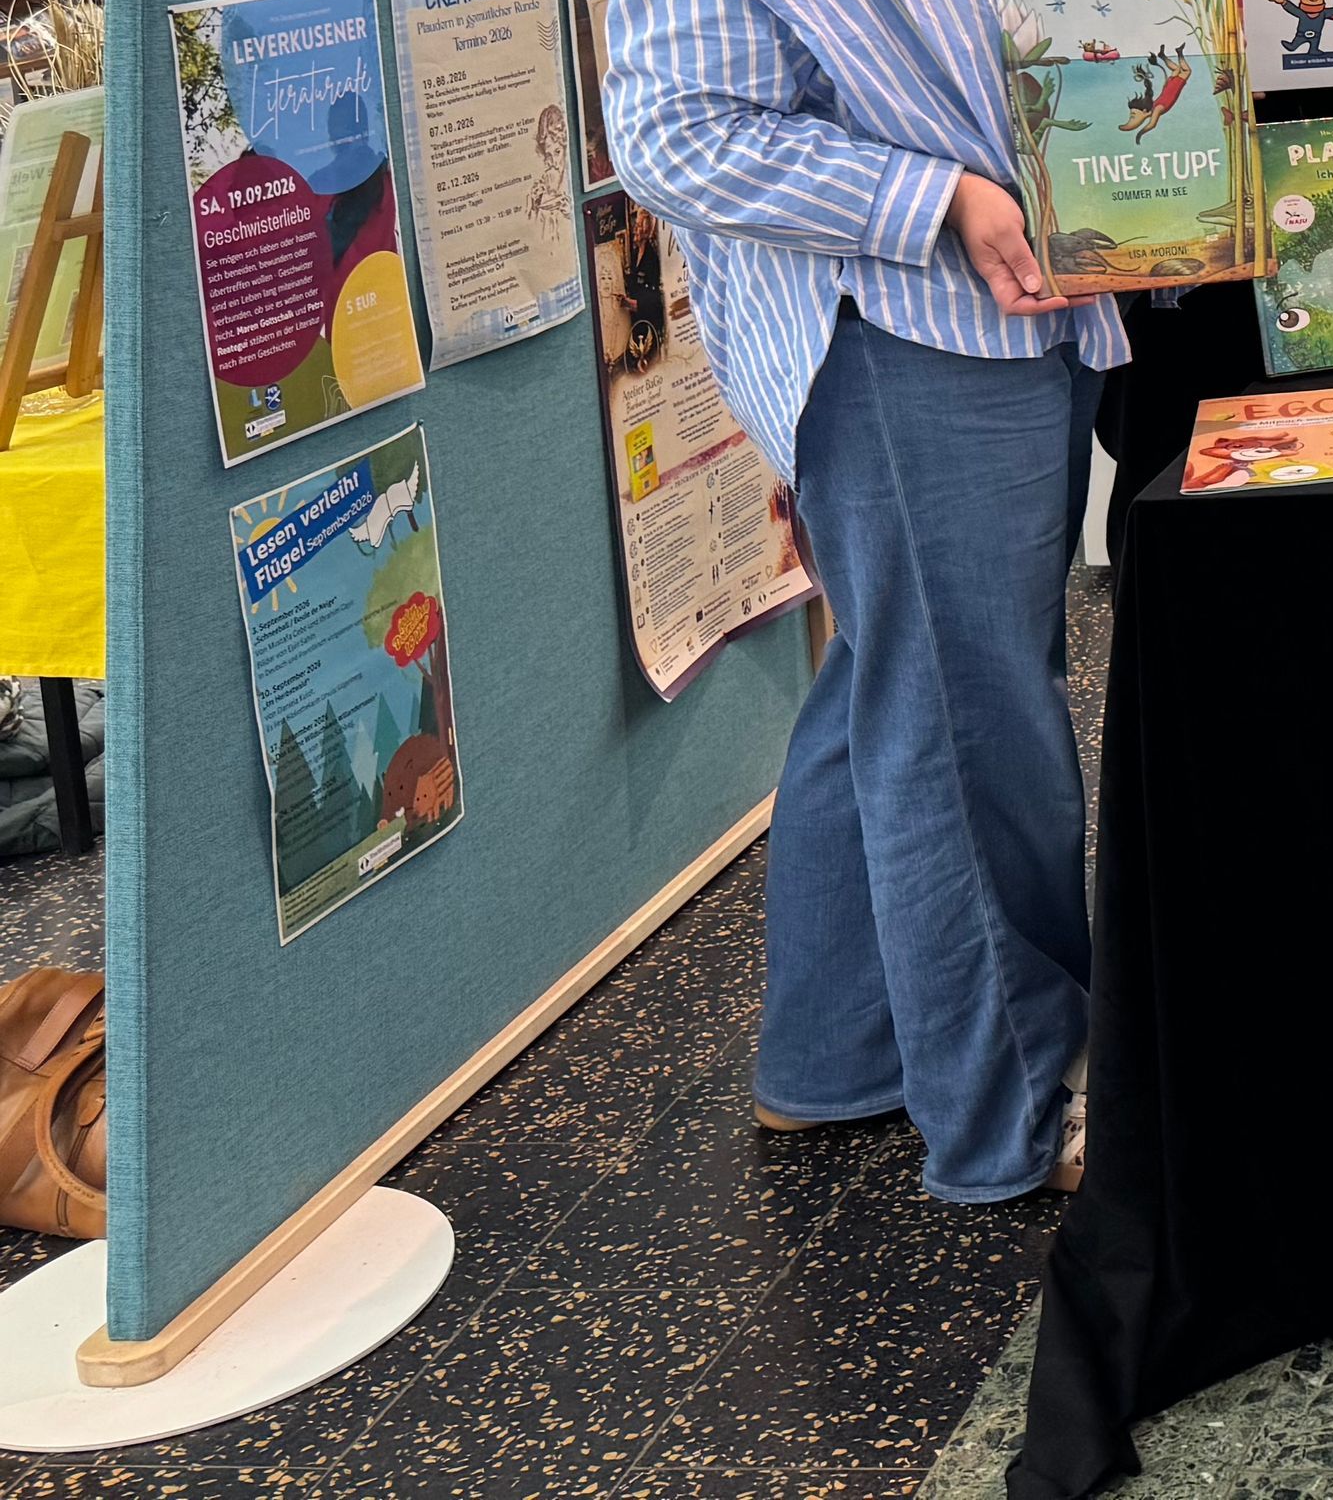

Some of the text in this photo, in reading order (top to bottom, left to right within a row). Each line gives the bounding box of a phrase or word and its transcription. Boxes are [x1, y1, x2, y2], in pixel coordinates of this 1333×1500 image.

[417, 17, 454, 35] Plaudern
[456, 15, 464, 26] in
[514, 0, 540, 14] Runde
[232, 17, 367, 65] LEVERKUSENER
[452, 27, 512, 52] Termine 2026
[1072, 149, 1221, 185] TINE & TUPF
[1316, 169, 1333, 180] Ich
[200, 176, 296, 216] SA, 19.09.2026
[1111, 186, 1188, 201] SOMMER AM SEE
[204, 205, 311, 249] Geschwisterliebe
[1128, 246, 1188, 259] LISA MORONI
[346, 292, 377, 315] 5 EUR
[247, 471, 360, 566] Lesen verleiht
[254, 491, 373, 590] Flügel September 2026
